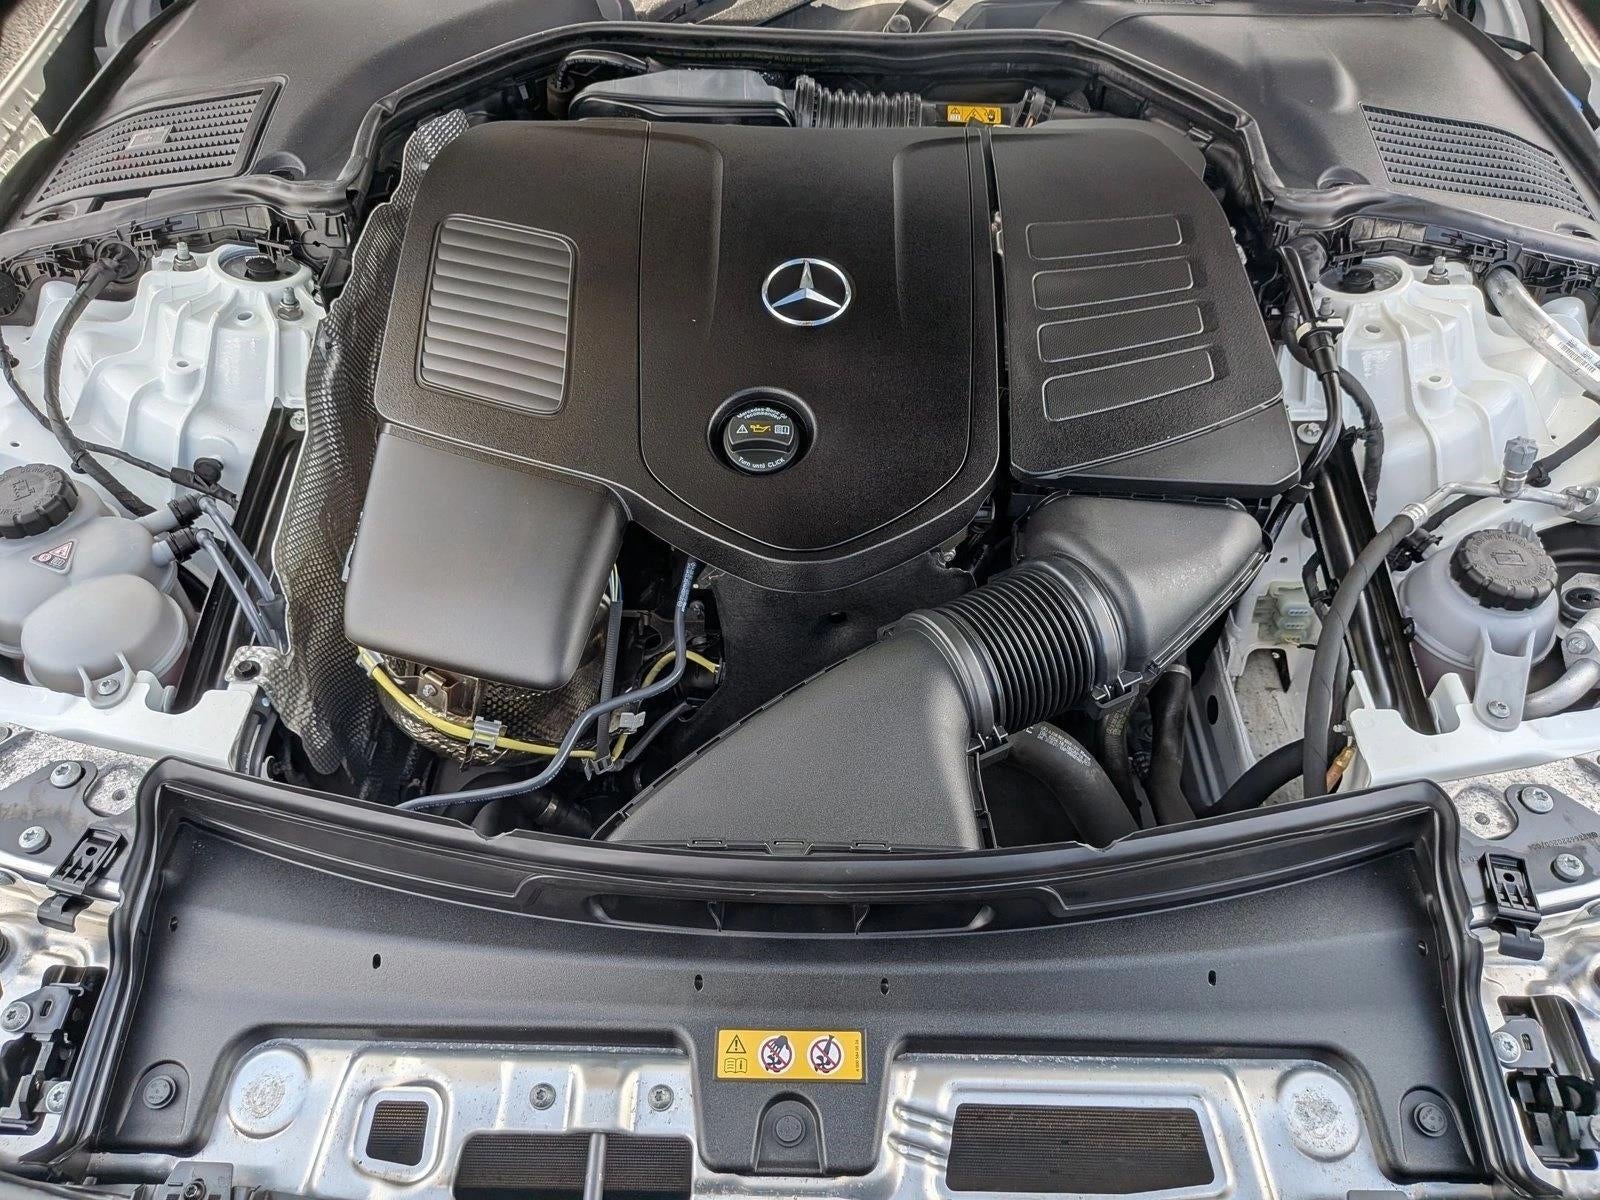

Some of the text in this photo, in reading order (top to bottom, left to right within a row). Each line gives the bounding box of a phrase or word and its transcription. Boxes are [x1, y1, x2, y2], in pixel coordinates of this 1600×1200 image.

[736, 407, 780, 419] Mercedes-Benz
[744, 411, 781, 420] recommended
[738, 456, 751, 467] Turn
[767, 457, 786, 468] CLICK
